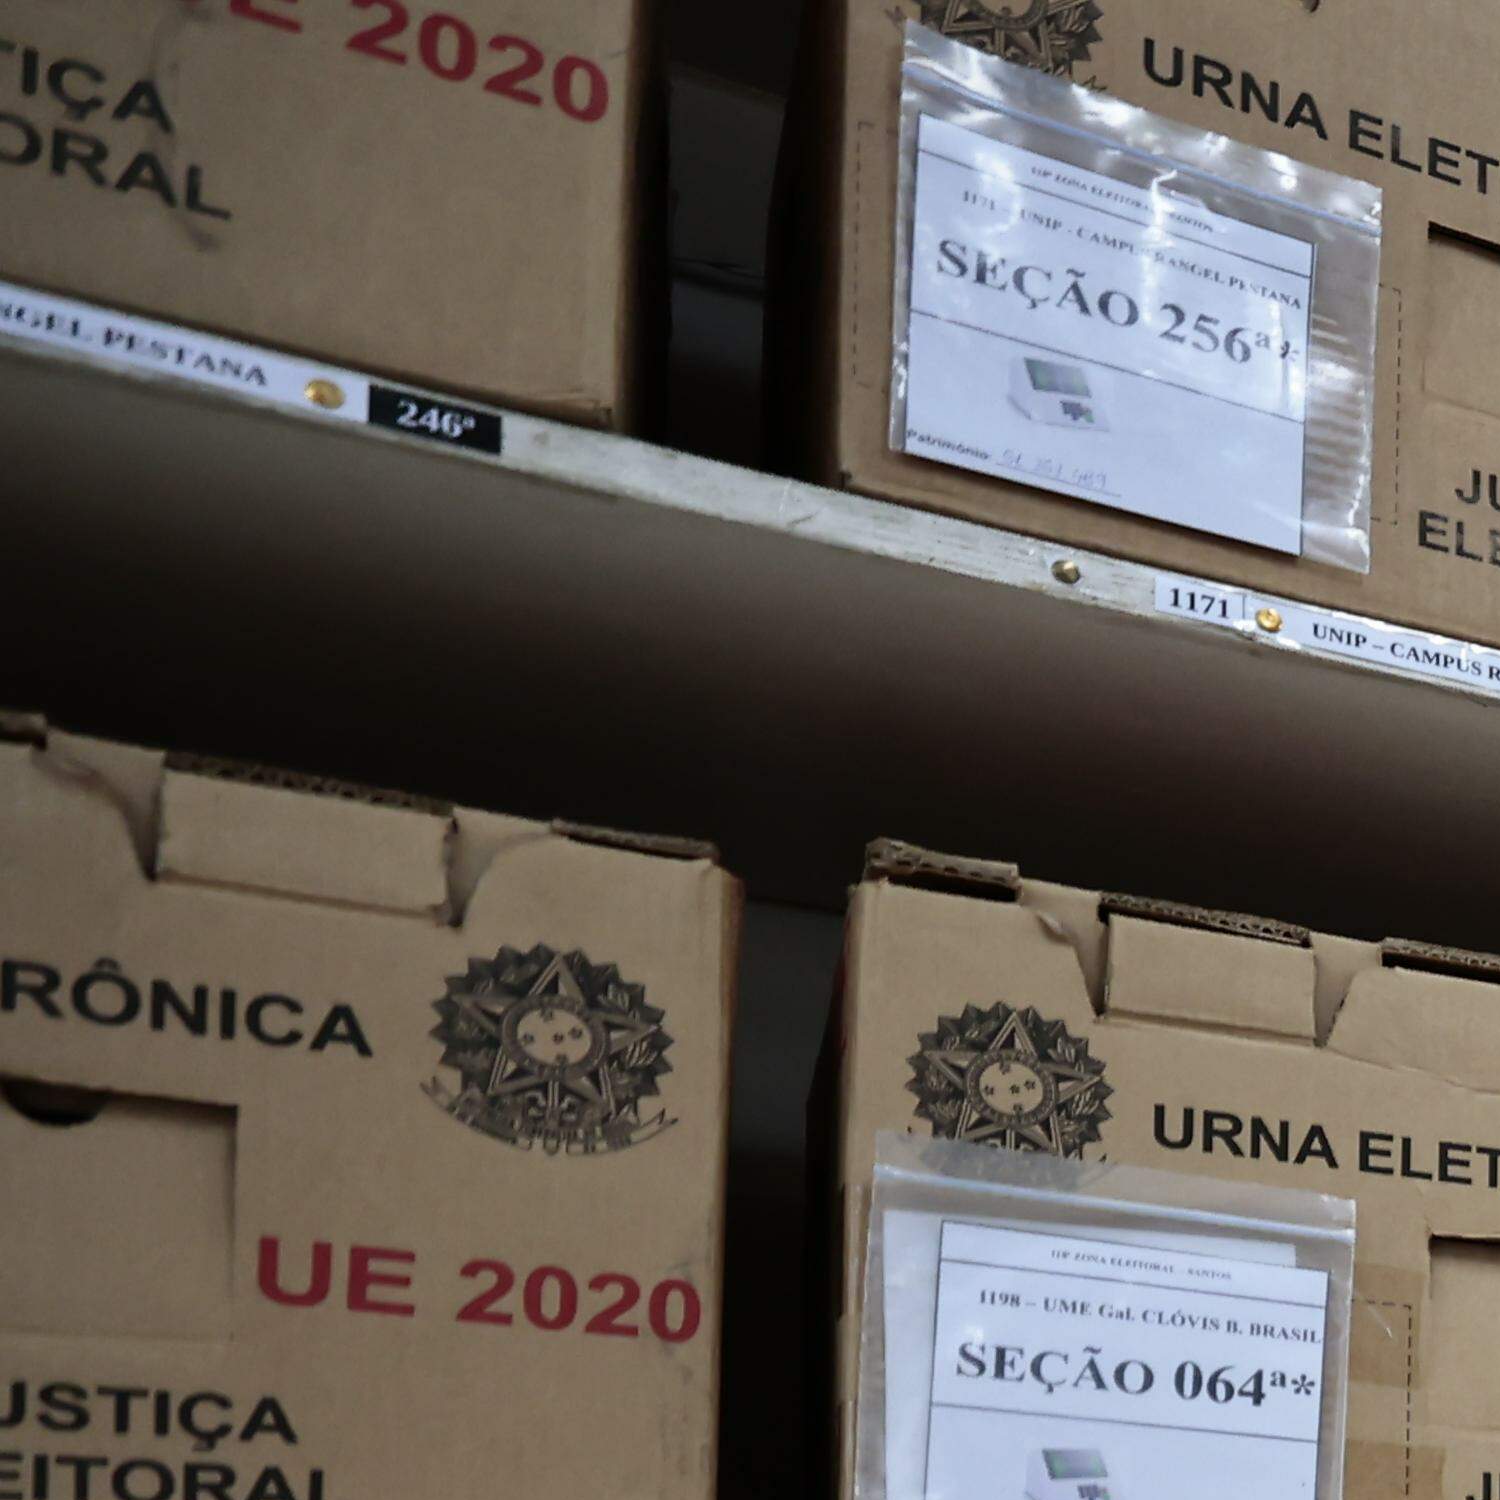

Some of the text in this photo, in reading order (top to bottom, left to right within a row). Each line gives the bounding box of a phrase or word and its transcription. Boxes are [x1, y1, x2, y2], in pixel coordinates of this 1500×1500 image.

[346, 0, 611, 123] 2020
[1145, 38, 1328, 139] URNA
[937, 238, 1140, 329] SEÇÃO
[103, 326, 268, 388] PESTANA
[1168, 587, 1231, 619] 1171
[1312, 623, 1367, 650] UNIP
[1390, 642, 1485, 679] CAMPUS
[1153, 1103, 1339, 1172] URNA
[257, 1236, 703, 1344] UE 2020
[1043, 1296, 1093, 1318] UME
[1141, 1303, 1220, 1333] CLÓVIS
[1249, 1323, 1322, 1345] BRASIL
[956, 1341, 1155, 1397] SEÇÃO
